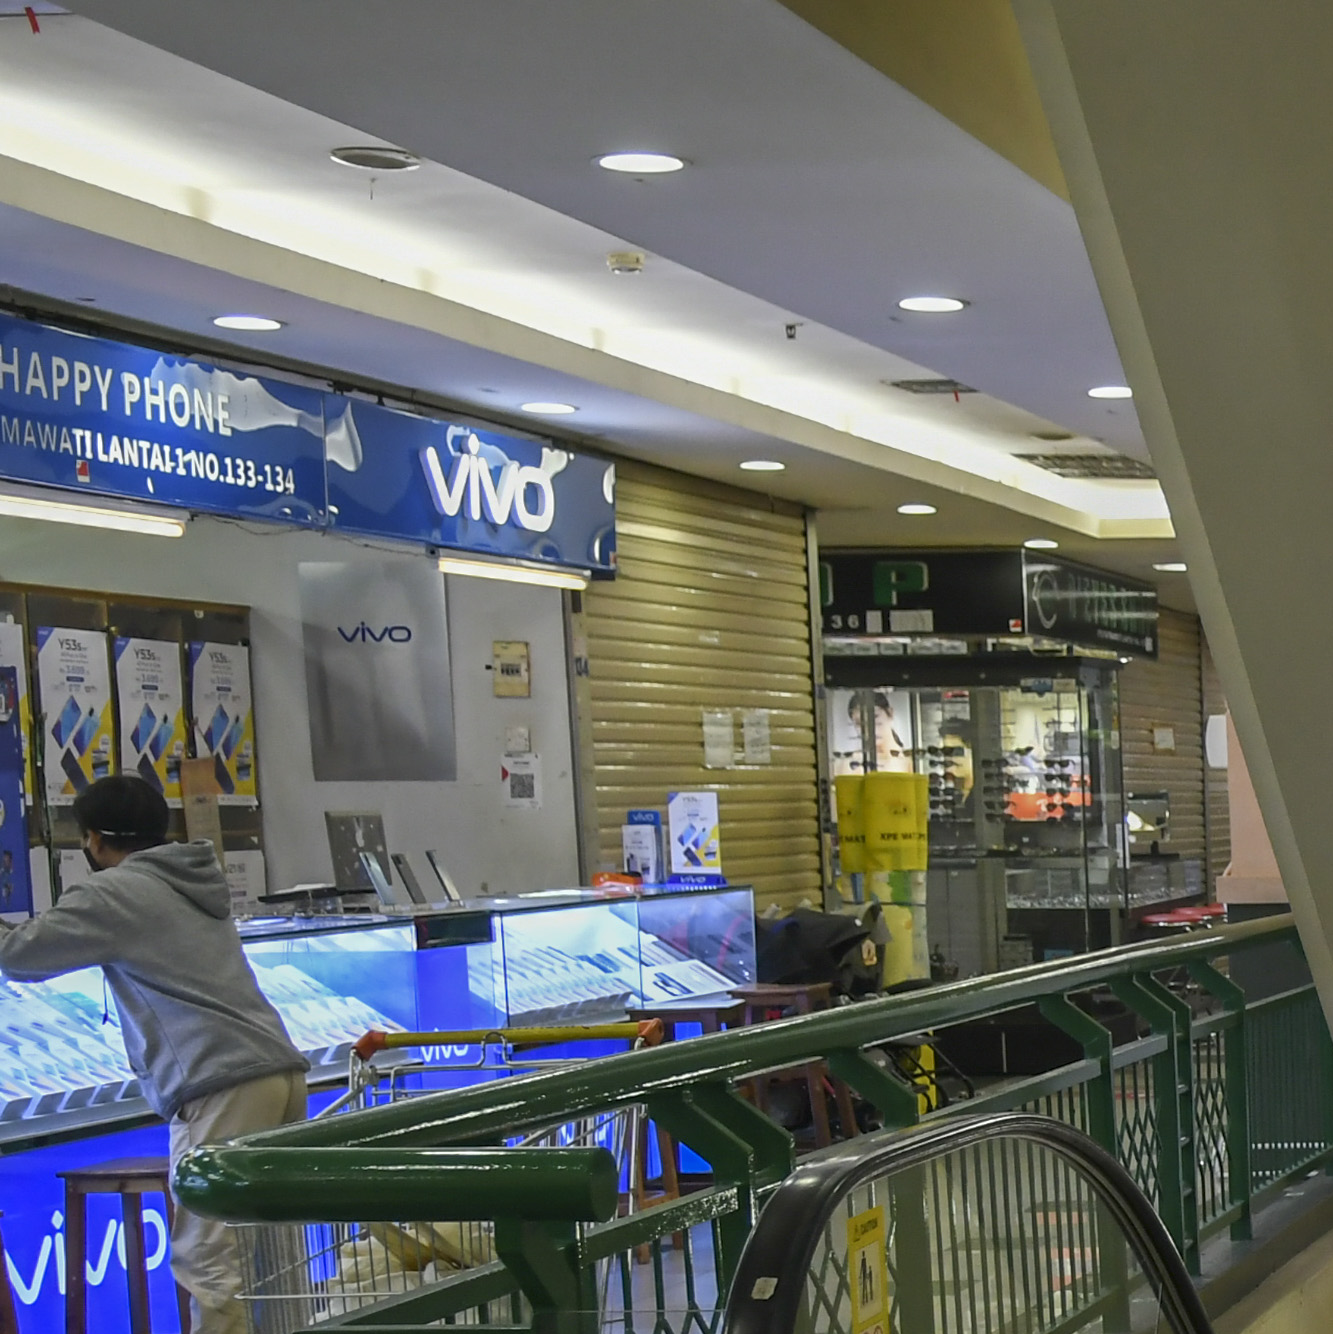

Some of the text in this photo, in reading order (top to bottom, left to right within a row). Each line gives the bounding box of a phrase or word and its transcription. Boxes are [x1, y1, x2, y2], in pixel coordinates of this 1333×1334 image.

[0, 347, 233, 437] HAPPY PHONE
[420, 433, 556, 533] vivo
[337, 621, 412, 643] vivo
[420, 1029, 470, 1064] vivo
